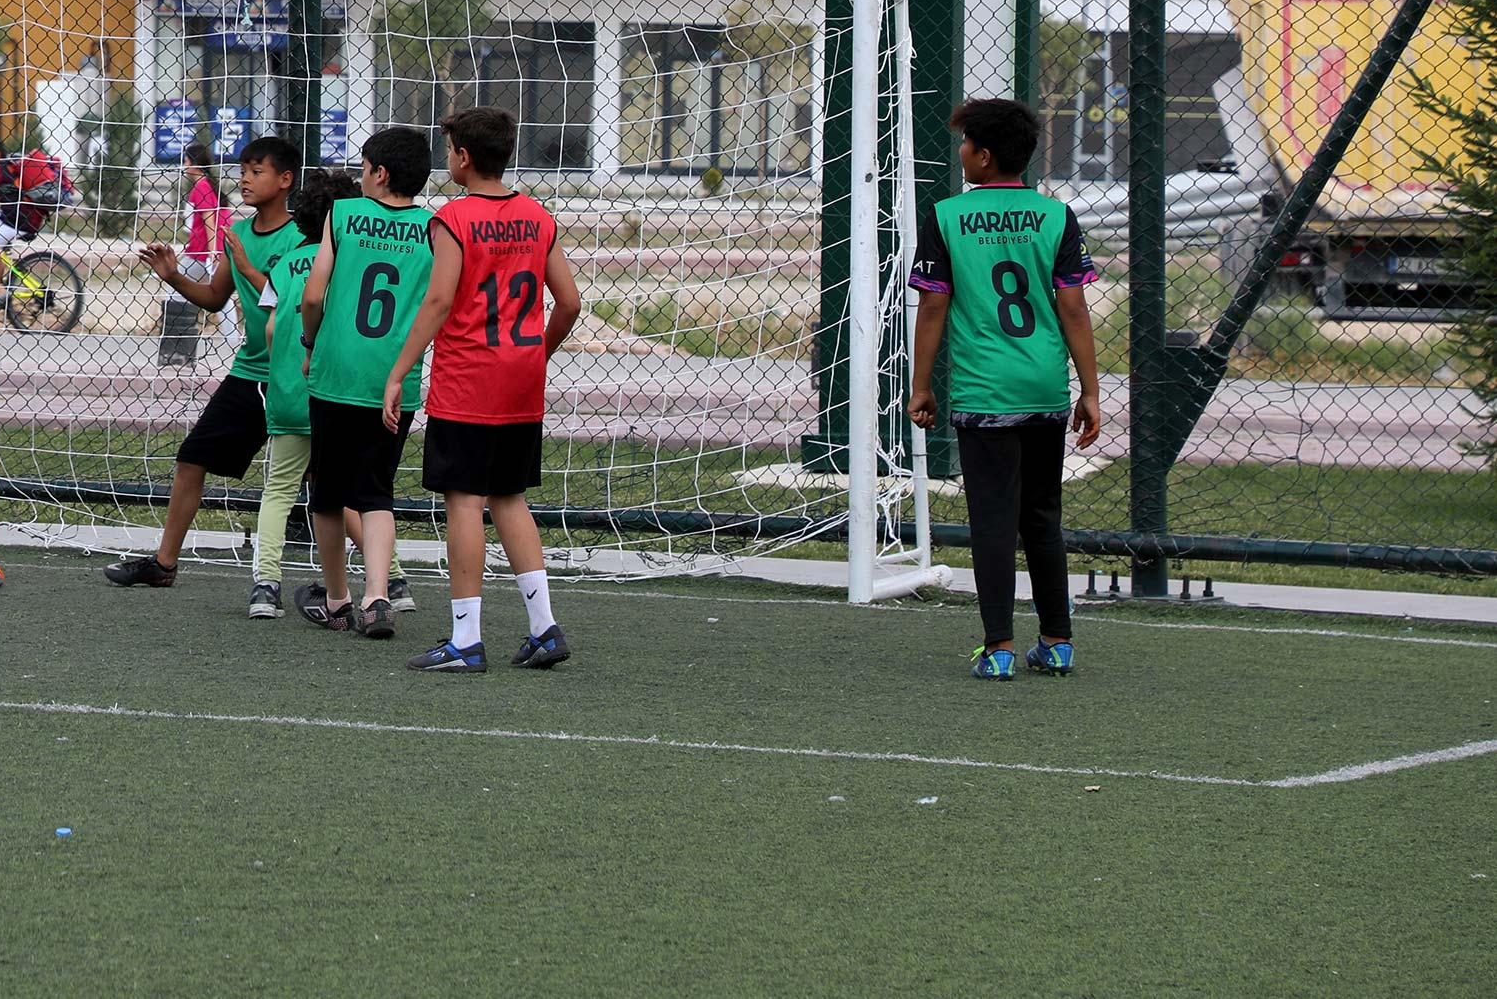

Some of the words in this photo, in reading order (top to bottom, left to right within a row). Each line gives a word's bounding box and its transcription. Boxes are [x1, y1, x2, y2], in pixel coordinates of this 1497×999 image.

[345, 215, 427, 244] KARATAY
[470, 219, 540, 243] KARATAY
[959, 210, 1046, 235] KARATAY
[359, 239, 415, 254] BELEDİYESİ
[355, 262, 400, 339] 6
[478, 270, 543, 347] 12
[991, 260, 1036, 338] 8
